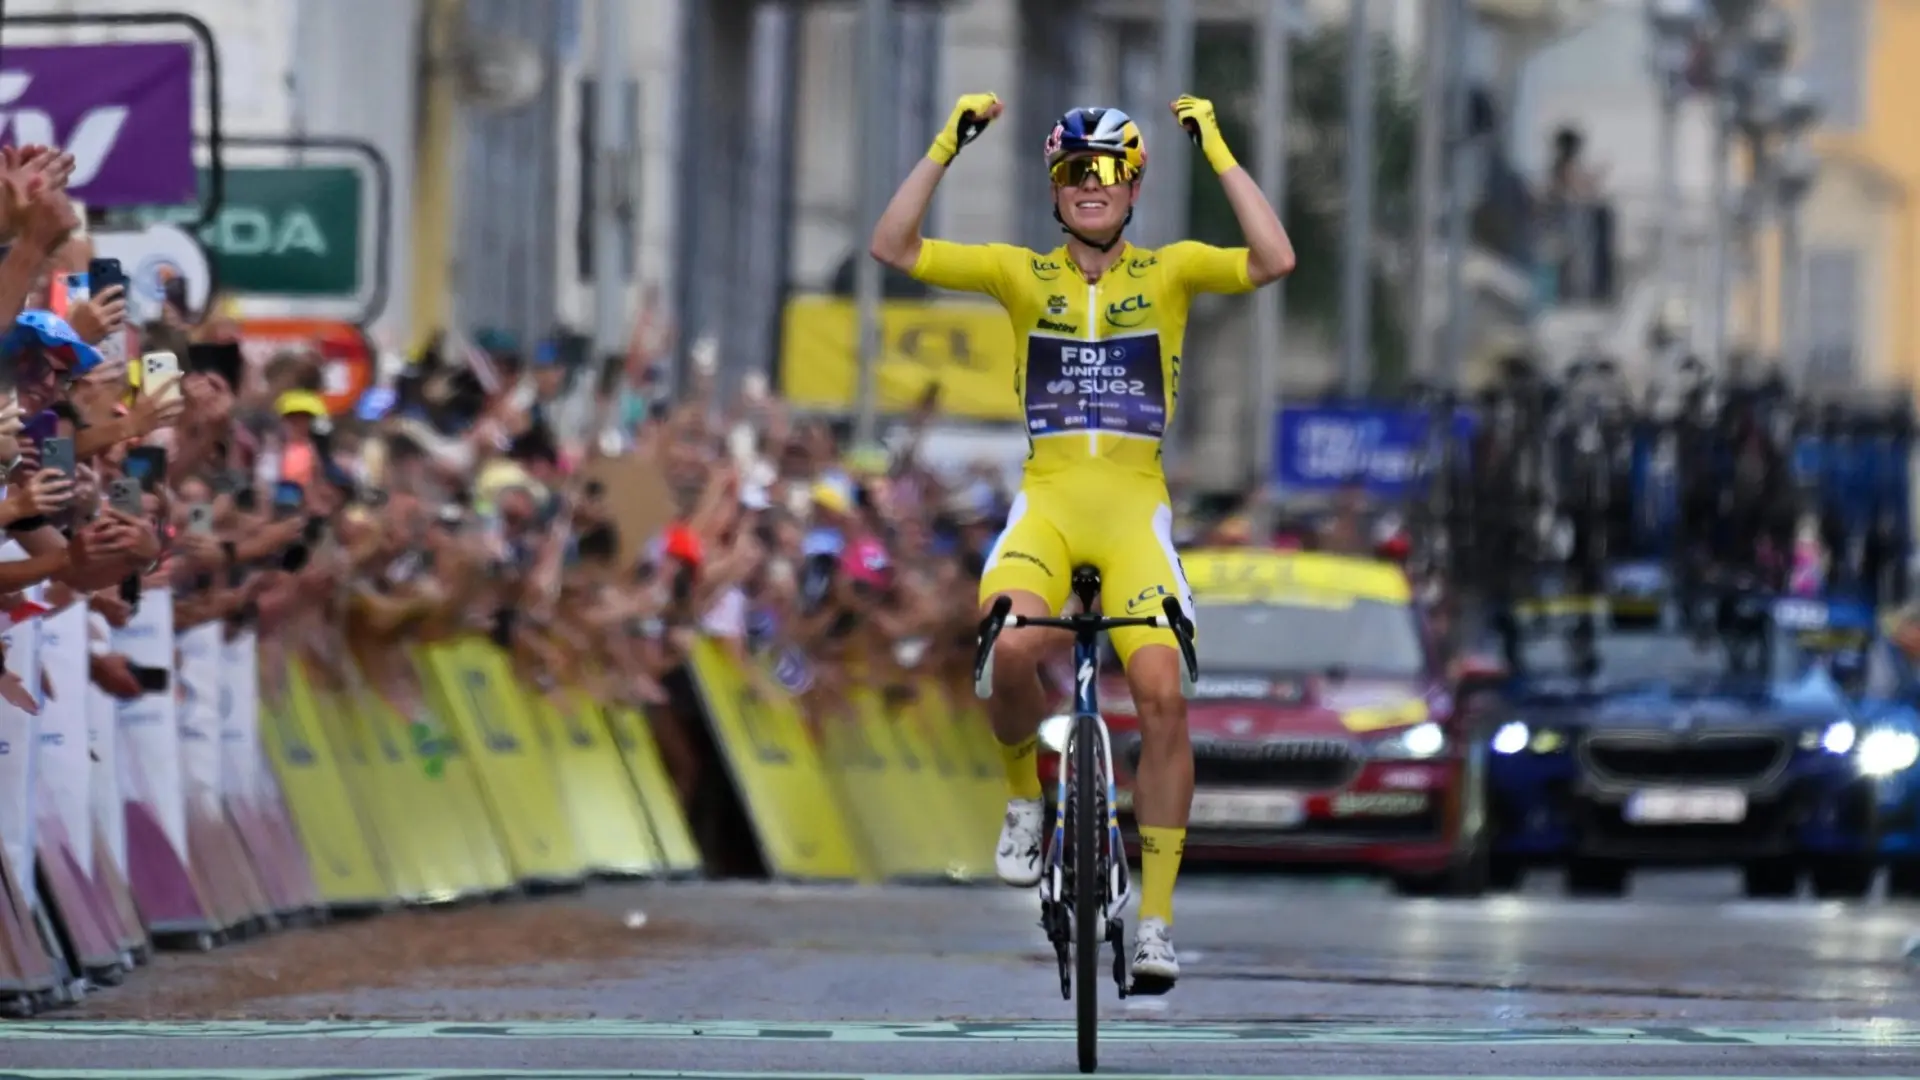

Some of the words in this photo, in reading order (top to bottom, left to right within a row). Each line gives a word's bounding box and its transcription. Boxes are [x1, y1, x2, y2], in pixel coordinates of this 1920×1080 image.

[1109, 294, 1152, 314] LCL
[1061, 346, 1107, 366] FDJ
[1061, 365, 1127, 377] UNITED
[1128, 584, 1175, 609] LCL
